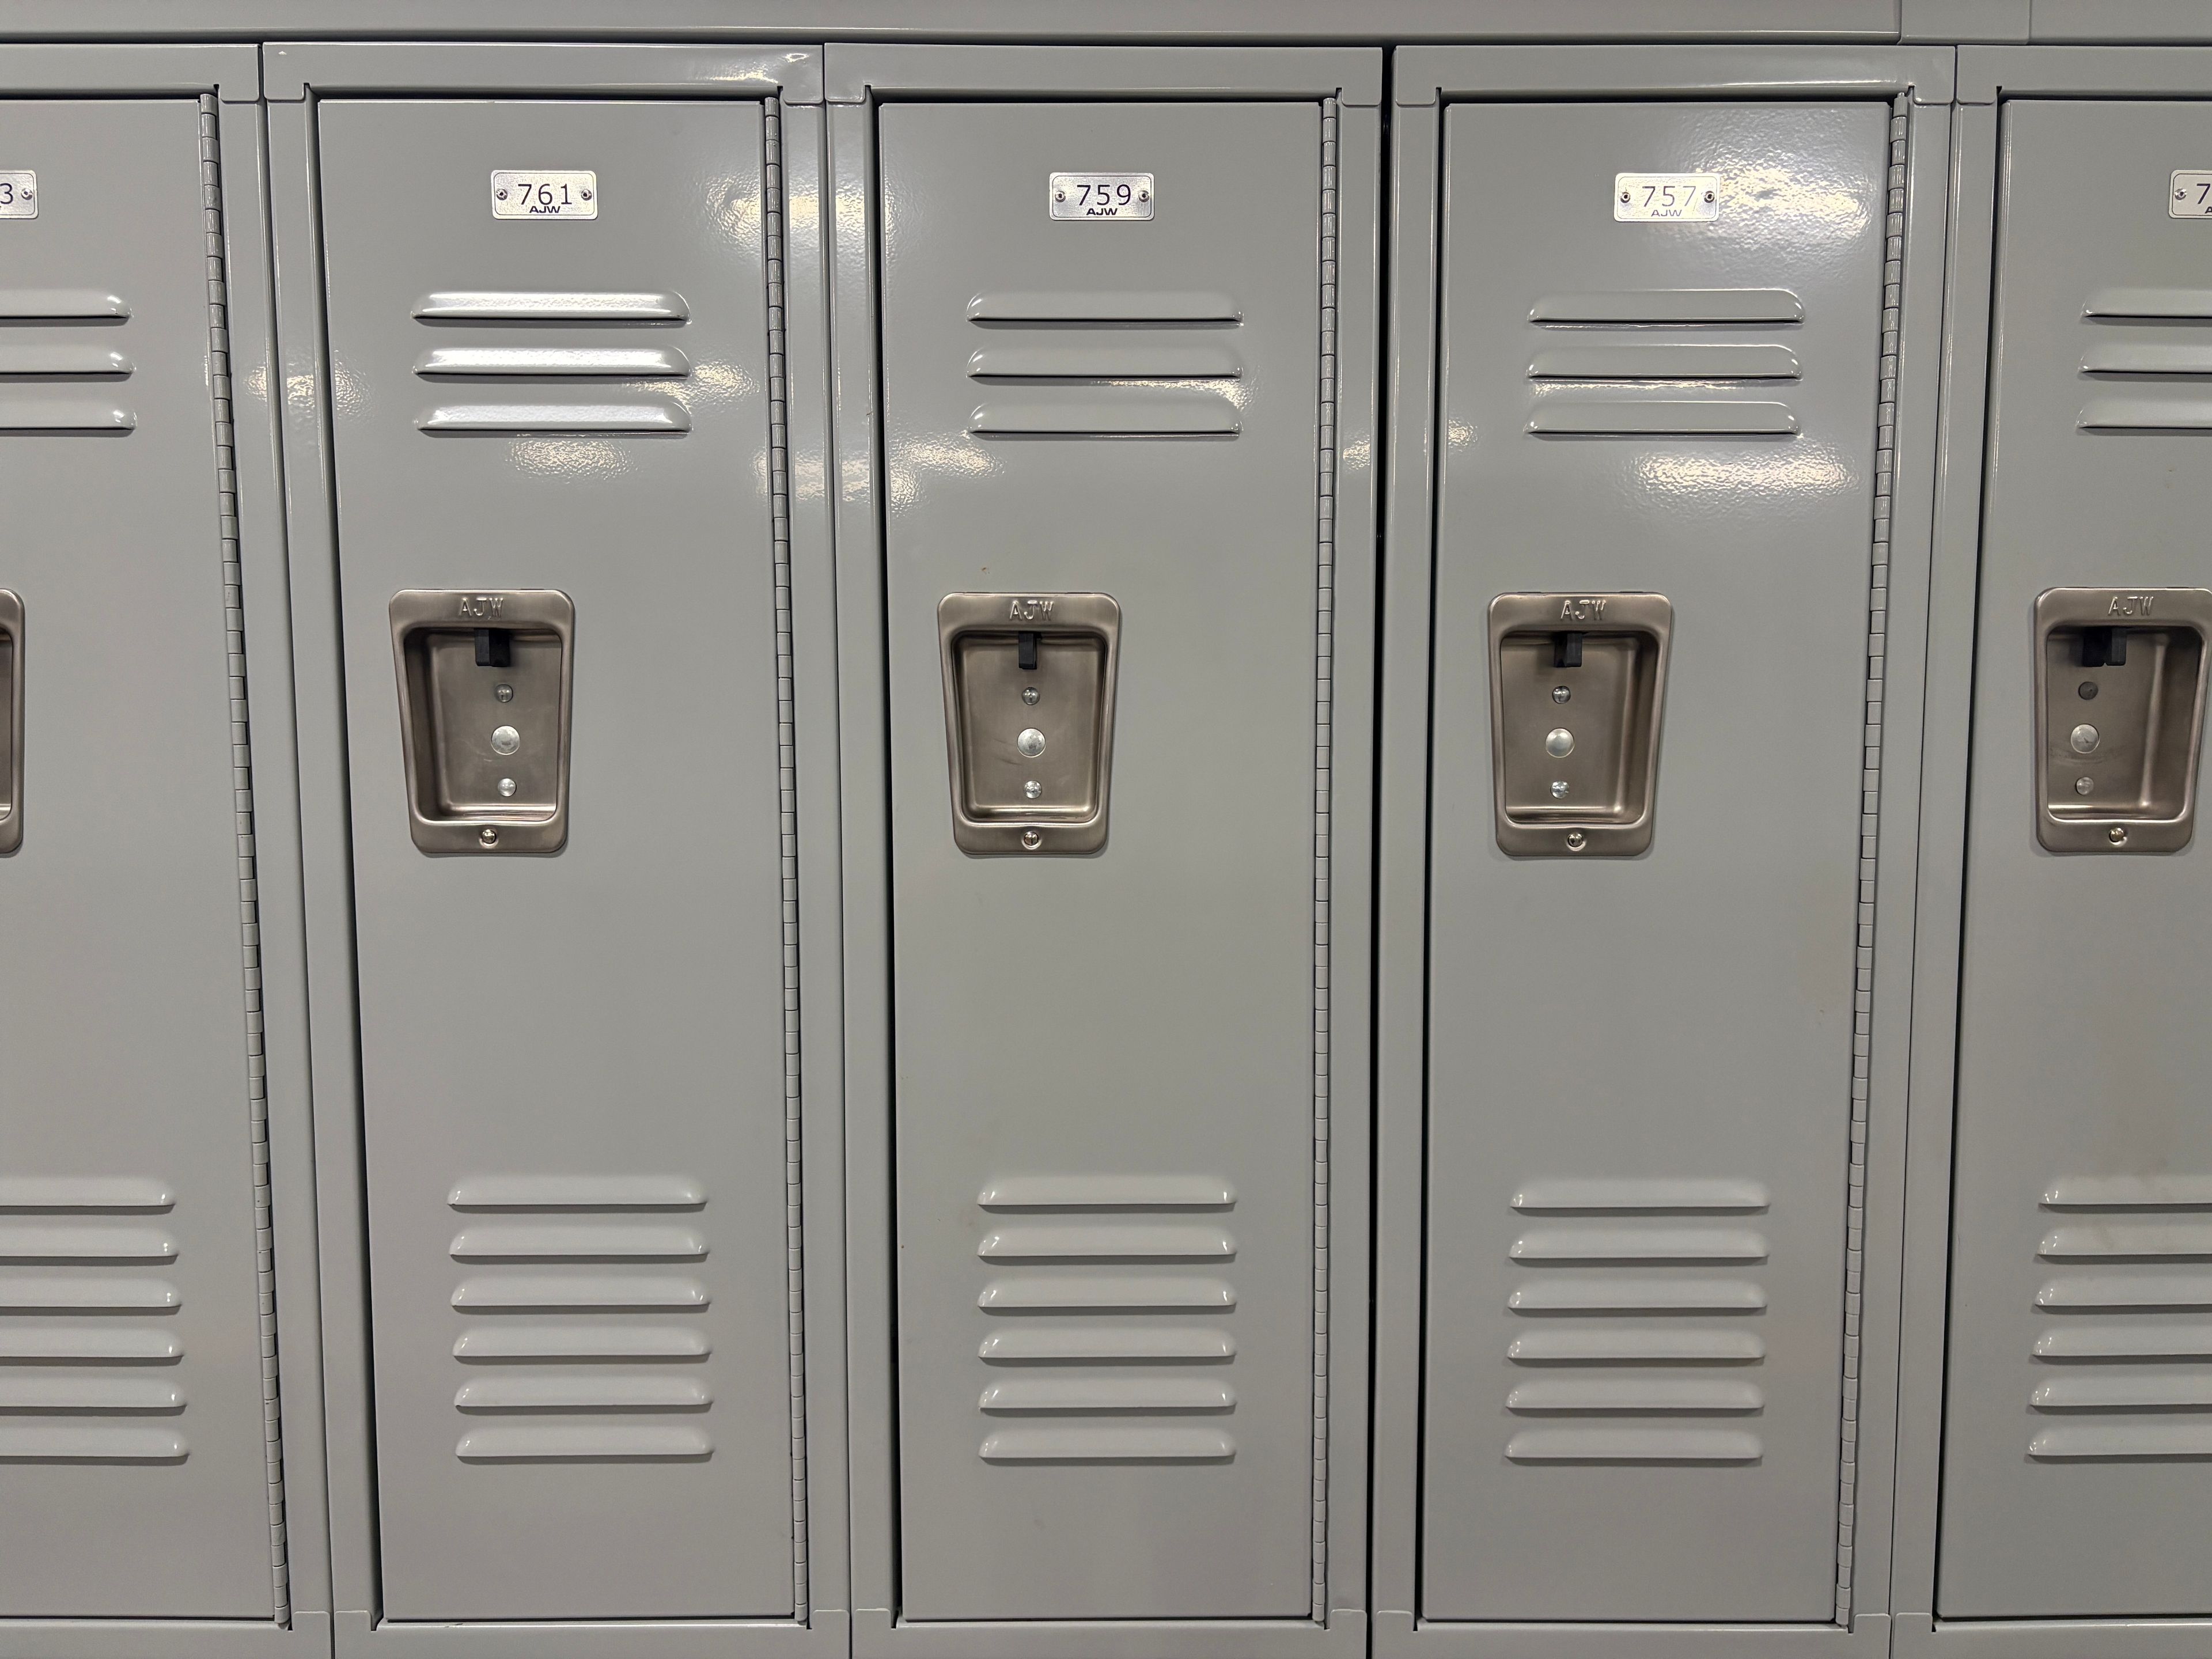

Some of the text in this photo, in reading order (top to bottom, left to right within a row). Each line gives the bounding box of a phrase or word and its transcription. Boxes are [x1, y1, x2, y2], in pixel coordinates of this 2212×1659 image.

[518, 183, 572, 205] 761
[1077, 184, 1131, 206] 759
[1642, 185, 1696, 207] 757
[529, 206, 560, 214] AJW
[1086, 207, 1118, 215] AJW
[459, 597, 503, 617] AJW
[1009, 600, 1054, 621] AJW
[1560, 599, 1606, 620] AJW
[2108, 596, 2154, 617] AJW
